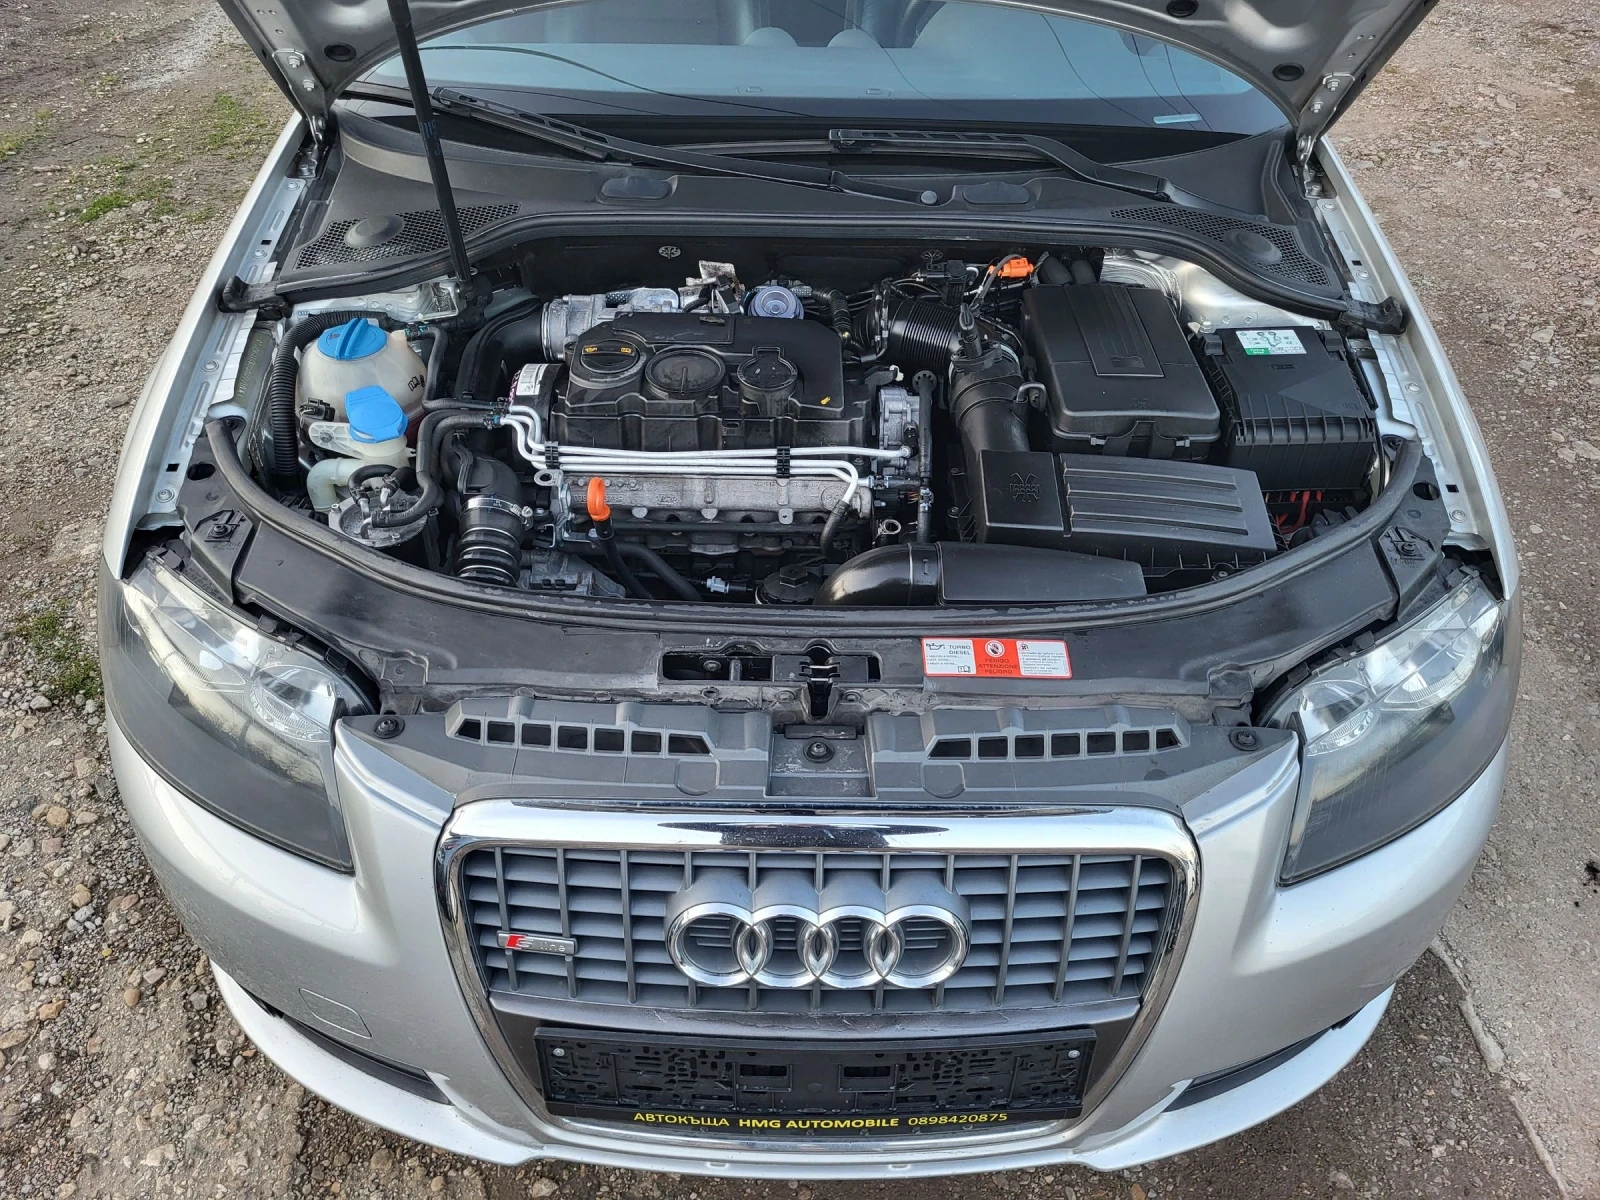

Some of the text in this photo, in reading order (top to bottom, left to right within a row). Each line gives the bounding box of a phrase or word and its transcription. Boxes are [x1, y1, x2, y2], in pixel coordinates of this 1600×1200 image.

[633, 1112, 1008, 1129] АВТОКЪЩА HMG AUTOMOBILE 0898420875
